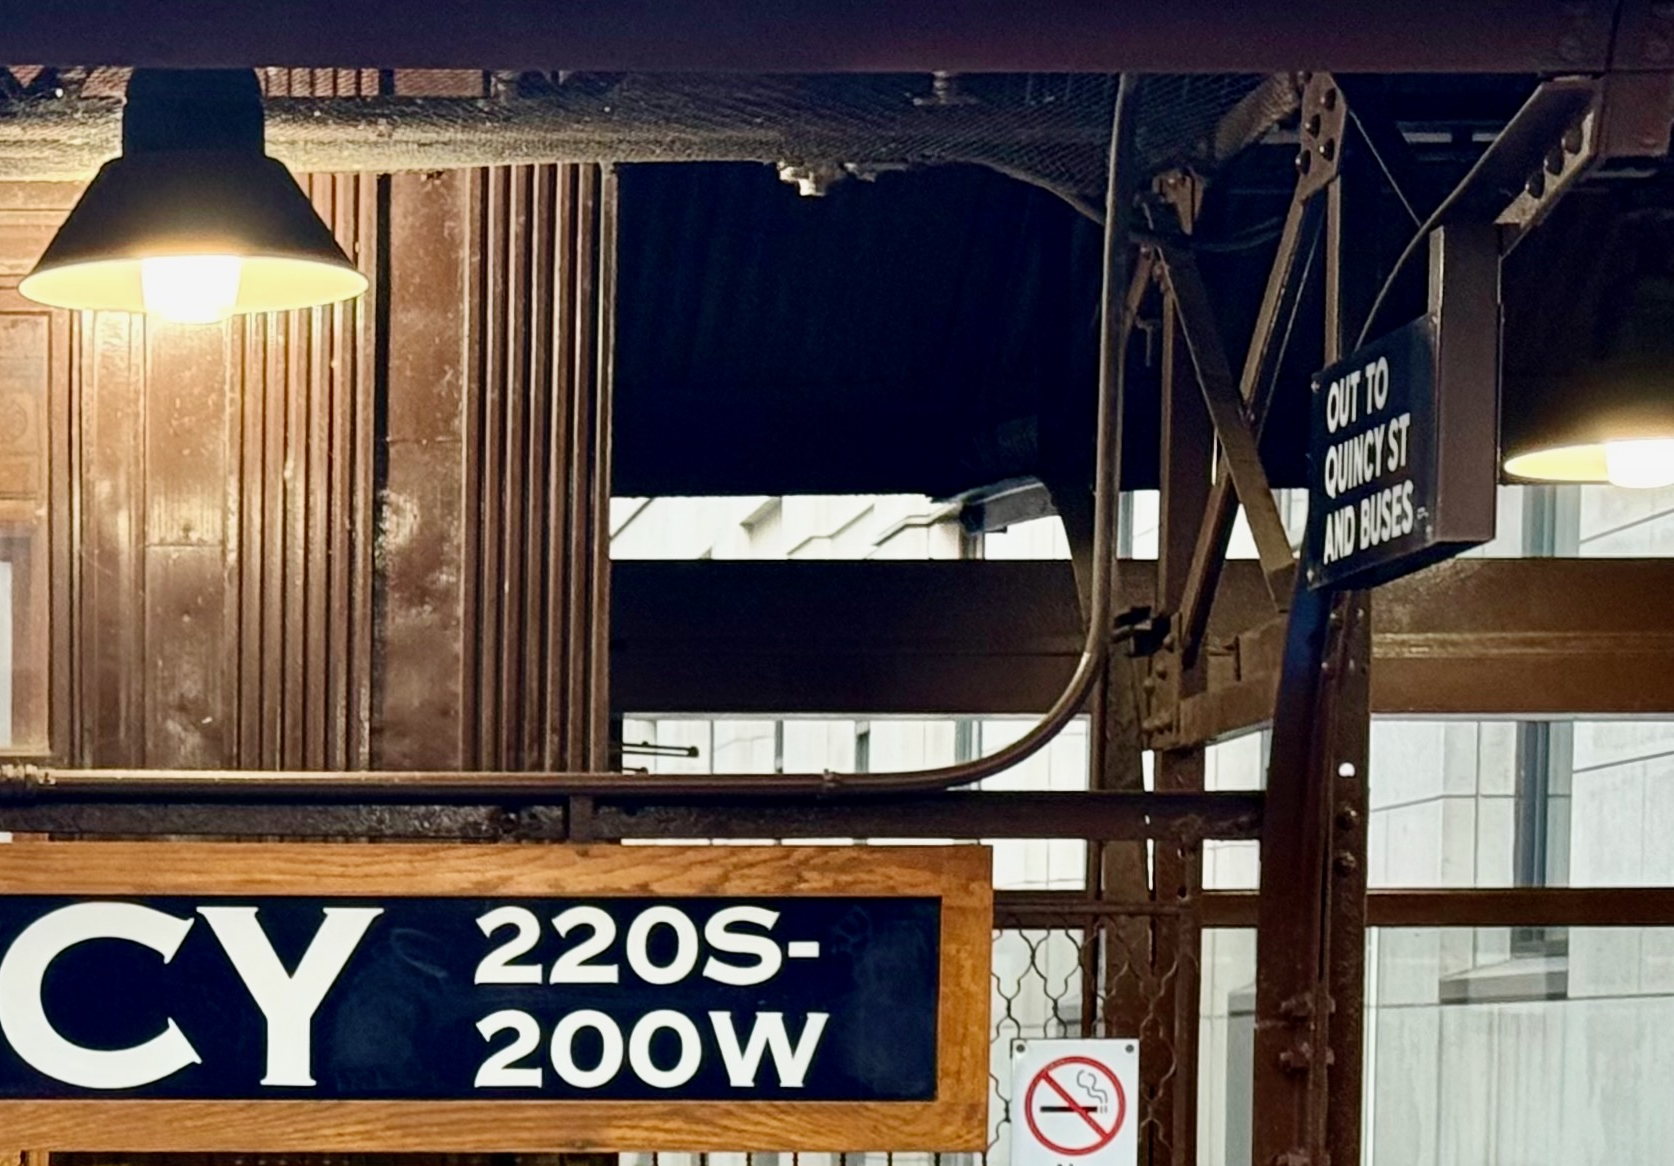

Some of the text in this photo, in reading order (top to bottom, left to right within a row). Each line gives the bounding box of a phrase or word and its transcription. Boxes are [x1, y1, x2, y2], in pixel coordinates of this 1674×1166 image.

[1326, 356, 1389, 434] OUT TO
[1324, 412, 1411, 499] QUINCY ST
[1323, 479, 1414, 565] AND BUSES
[473, 905, 820, 986] 220S-
[473, 1009, 830, 1089] 200W
